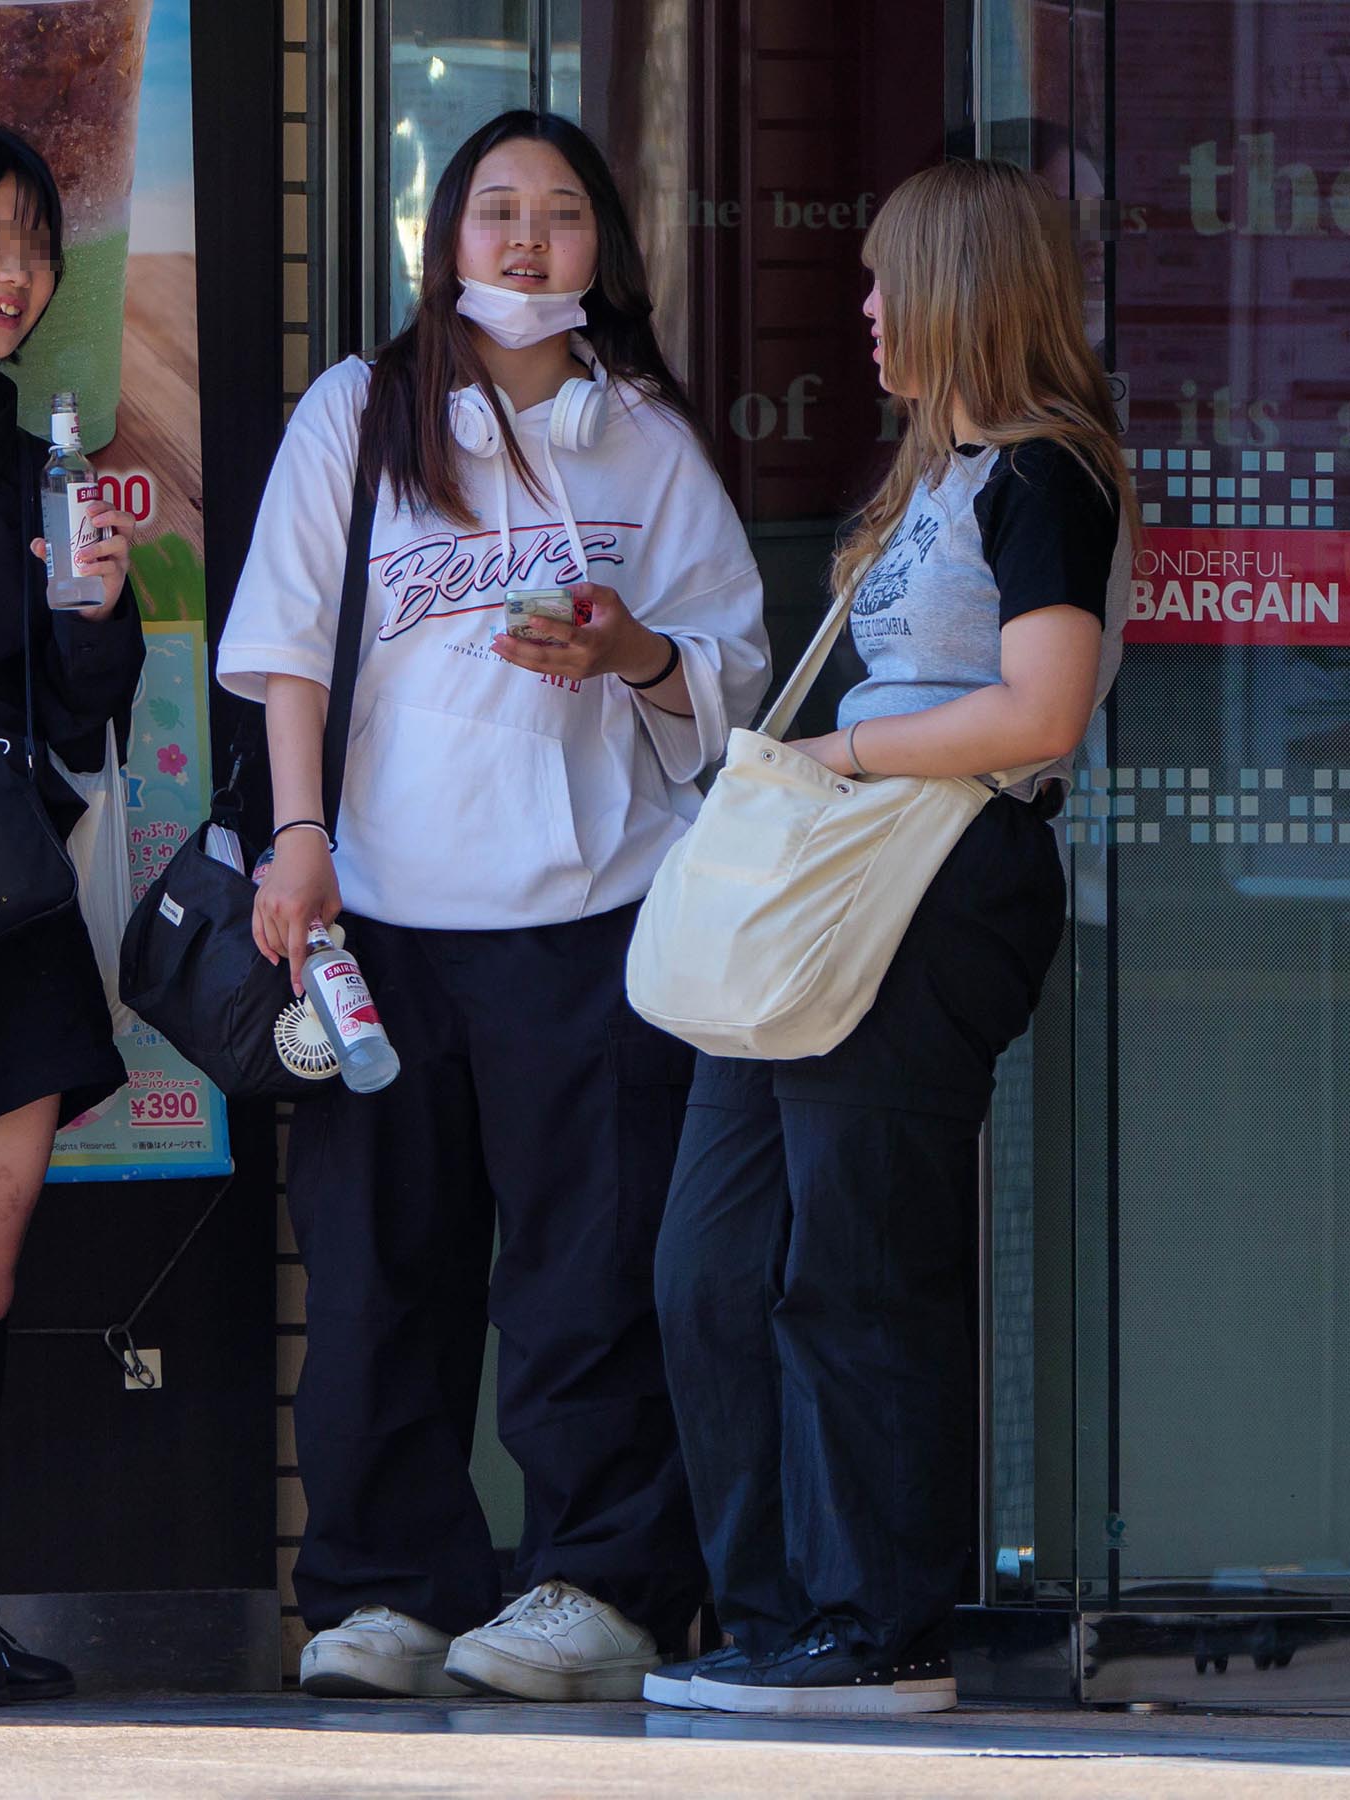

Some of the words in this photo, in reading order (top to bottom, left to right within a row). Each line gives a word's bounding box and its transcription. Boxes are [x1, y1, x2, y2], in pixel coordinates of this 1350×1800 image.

[772, 191, 876, 230] beef
[729, 373, 823, 441] of
[1176, 379, 1280, 448] its
[1132, 549, 1293, 578] ONDERFUL
[378, 530, 624, 641] Bears
[1128, 580, 1339, 624] BARGAIN
[130, 1091, 198, 1119] ¥390
